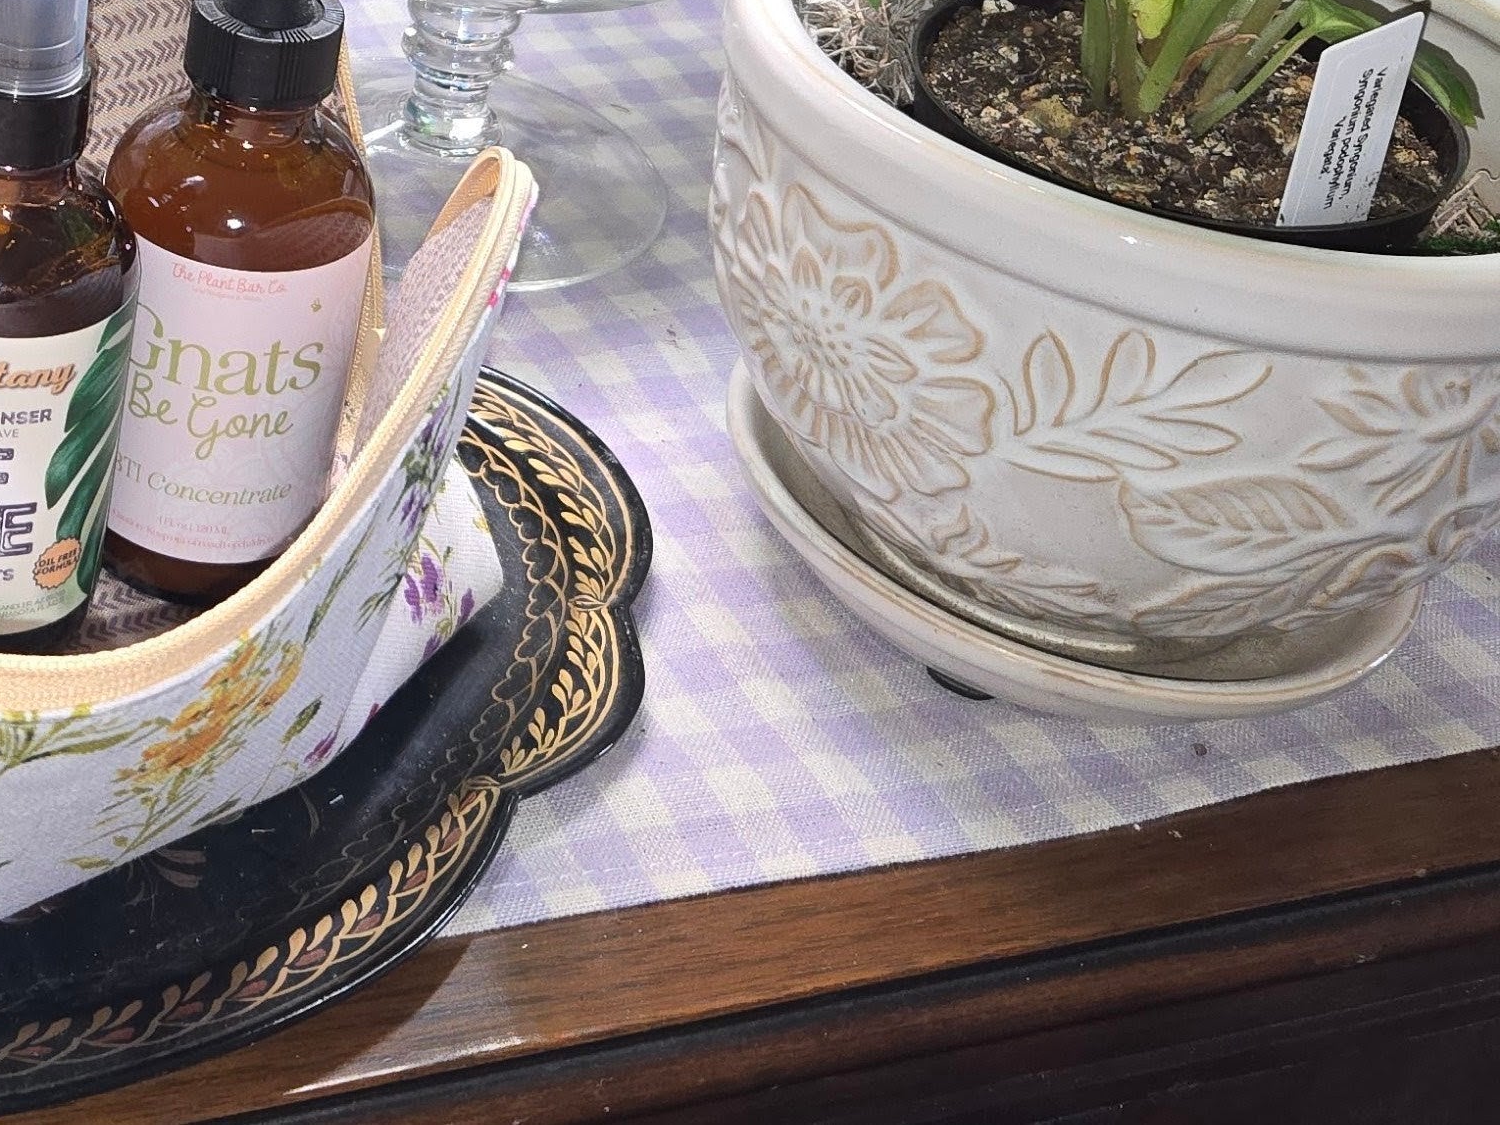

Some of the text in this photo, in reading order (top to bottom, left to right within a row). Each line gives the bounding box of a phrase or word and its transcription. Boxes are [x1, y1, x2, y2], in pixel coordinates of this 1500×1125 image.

[1345, 68, 1374, 135] Syngonium
[1361, 66, 1388, 132] Variegated
[171, 262, 195, 282] The
[197, 270, 236, 290] Plant
[236, 277, 265, 293] Bar
[128, 370, 294, 462] Be Gone
[147, 471, 292, 505] Concentrate
[39, 547, 78, 568] OIL FREE
